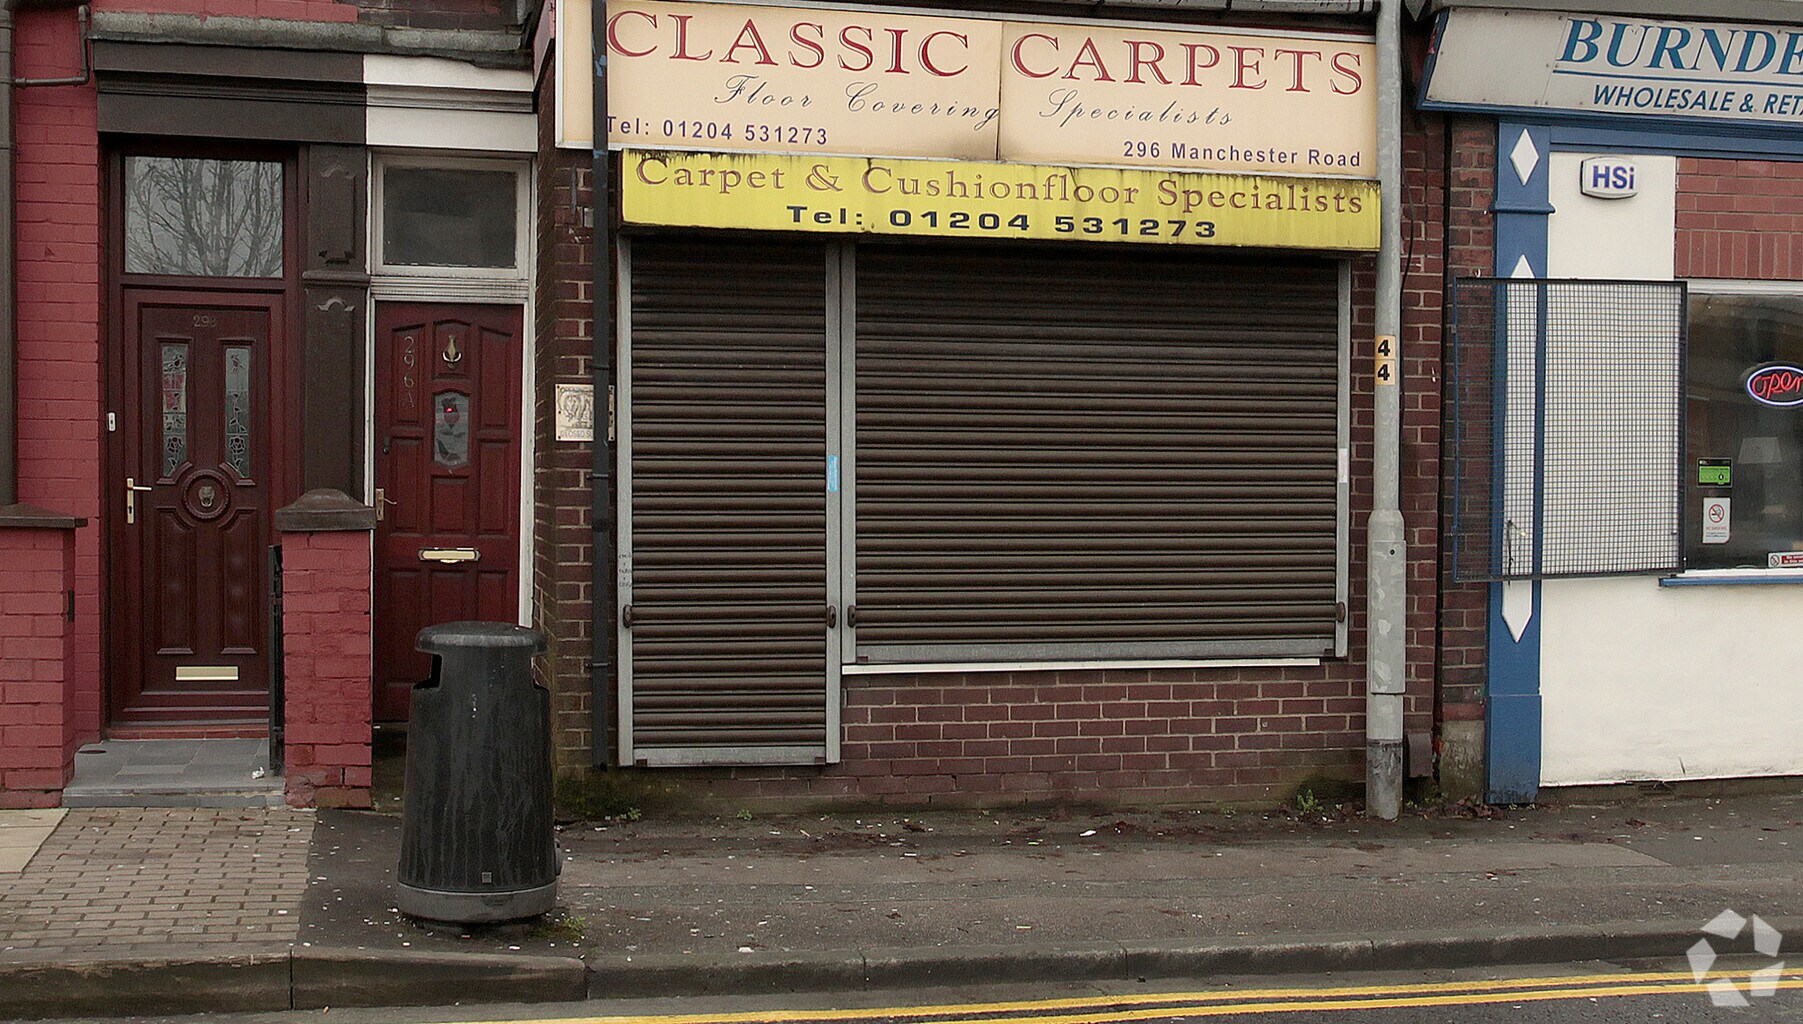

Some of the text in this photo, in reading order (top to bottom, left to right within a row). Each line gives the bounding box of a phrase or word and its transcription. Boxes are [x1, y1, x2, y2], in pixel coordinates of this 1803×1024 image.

[607, 11, 1362, 95] CLASSIC CARPETS
[713, 74, 1232, 131] Floor Covering Specialists
[1592, 84, 1803, 116] WHOLESALE & RET
[607, 116, 827, 145] Tel: 01204 531273
[1123, 141, 1361, 167] 296 Manchester Road
[636, 157, 1363, 215] Carpet & Cushionfloor Specialists
[1591, 165, 1635, 190] HSi
[786, 205, 1217, 239] Tel: 01204 531273
